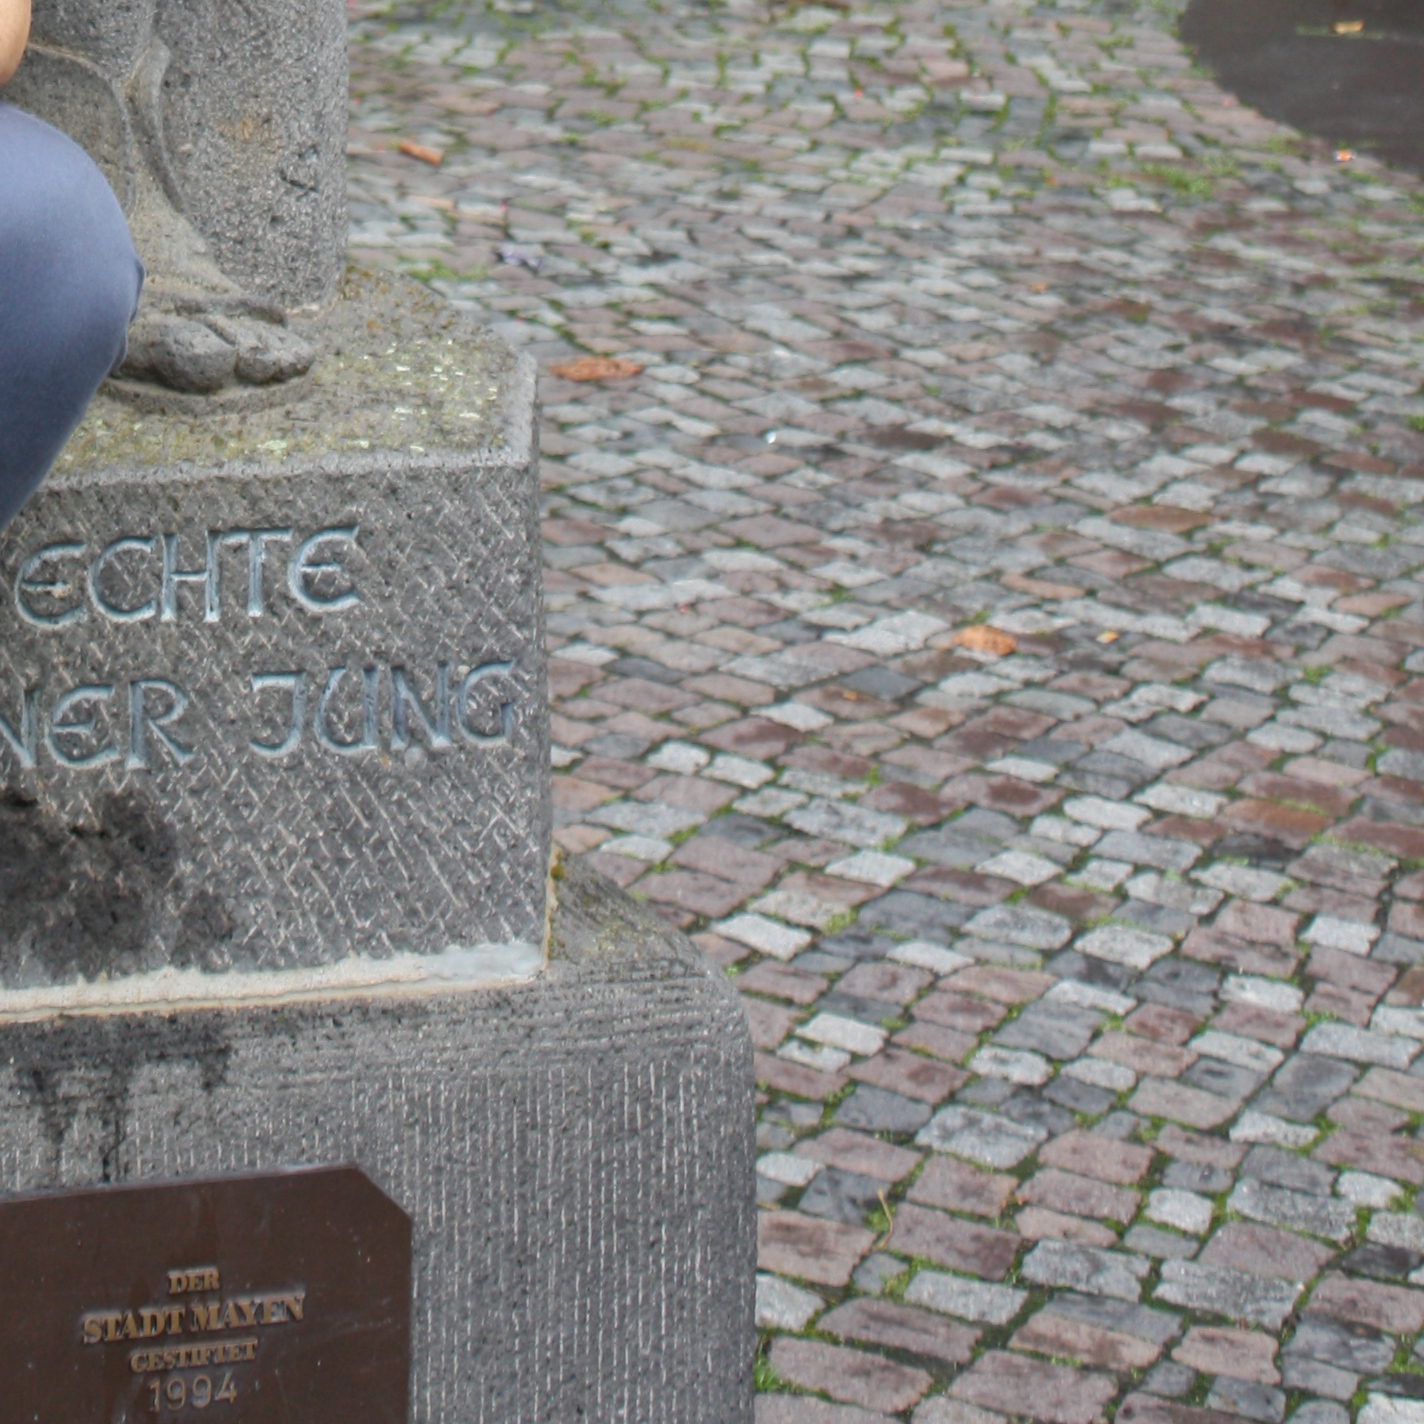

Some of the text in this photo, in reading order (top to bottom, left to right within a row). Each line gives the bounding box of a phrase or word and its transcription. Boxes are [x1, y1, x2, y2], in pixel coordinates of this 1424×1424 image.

[13, 525, 362, 631] ECHTE
[250, 659, 517, 759] JUNG
[167, 1265, 221, 1295] DER
[81, 1290, 306, 1345] STADT MAYEN
[130, 1337, 259, 1374] GESTIFTET
[149, 1370, 238, 1413] 1994
